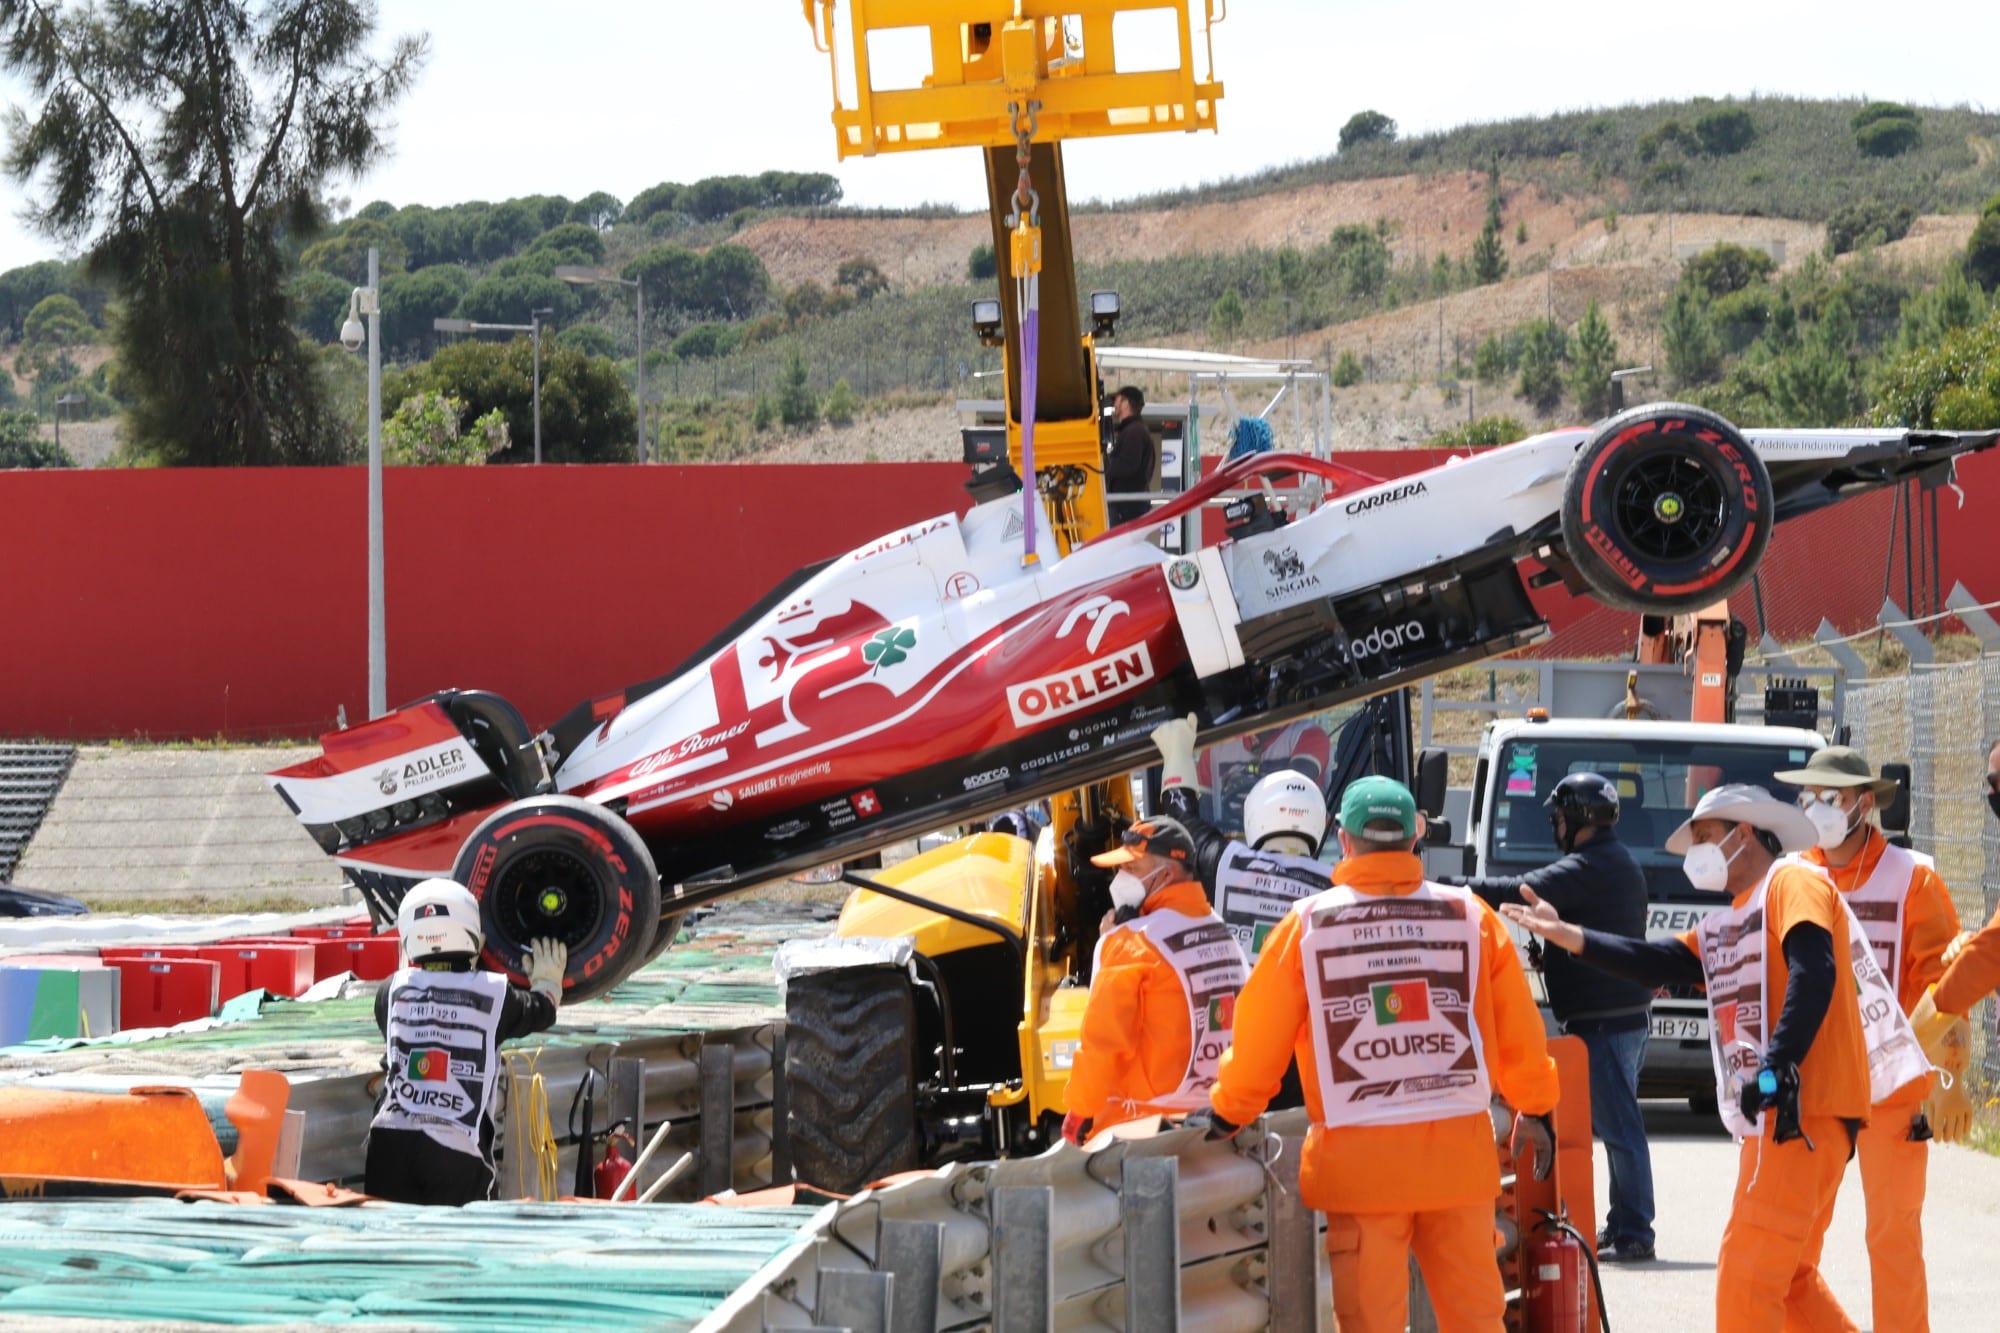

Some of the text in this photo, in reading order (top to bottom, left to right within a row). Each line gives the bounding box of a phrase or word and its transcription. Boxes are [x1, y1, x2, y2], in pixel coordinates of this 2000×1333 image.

[1759, 439, 1850, 450] Additive Industries
[1660, 420, 1758, 512] P ZERO
[1345, 481, 1427, 515] CARRERA
[1584, 524, 1648, 591] PIRELLI
[1265, 575, 1319, 597] SINGHA
[1338, 620, 1425, 664] adara
[1018, 652, 1144, 716] ORLEN
[403, 748, 464, 779] ADLER
[629, 719, 752, 778] Alfa Romeo
[405, 763, 467, 789] PELZER GROUP
[738, 761, 831, 800] SAUBER Engineering
[963, 766, 1010, 790] sparco
[467, 843, 497, 901] RELLI
[1256, 877, 1279, 889] PRT
[584, 887, 633, 977] ZERO
[1353, 925, 1424, 940] PRT 1183
[1368, 955, 1422, 969] FIRE MARSHAL
[1649, 1019, 1699, 1037] HB 79
[1353, 1034, 1456, 1062] COURSE
